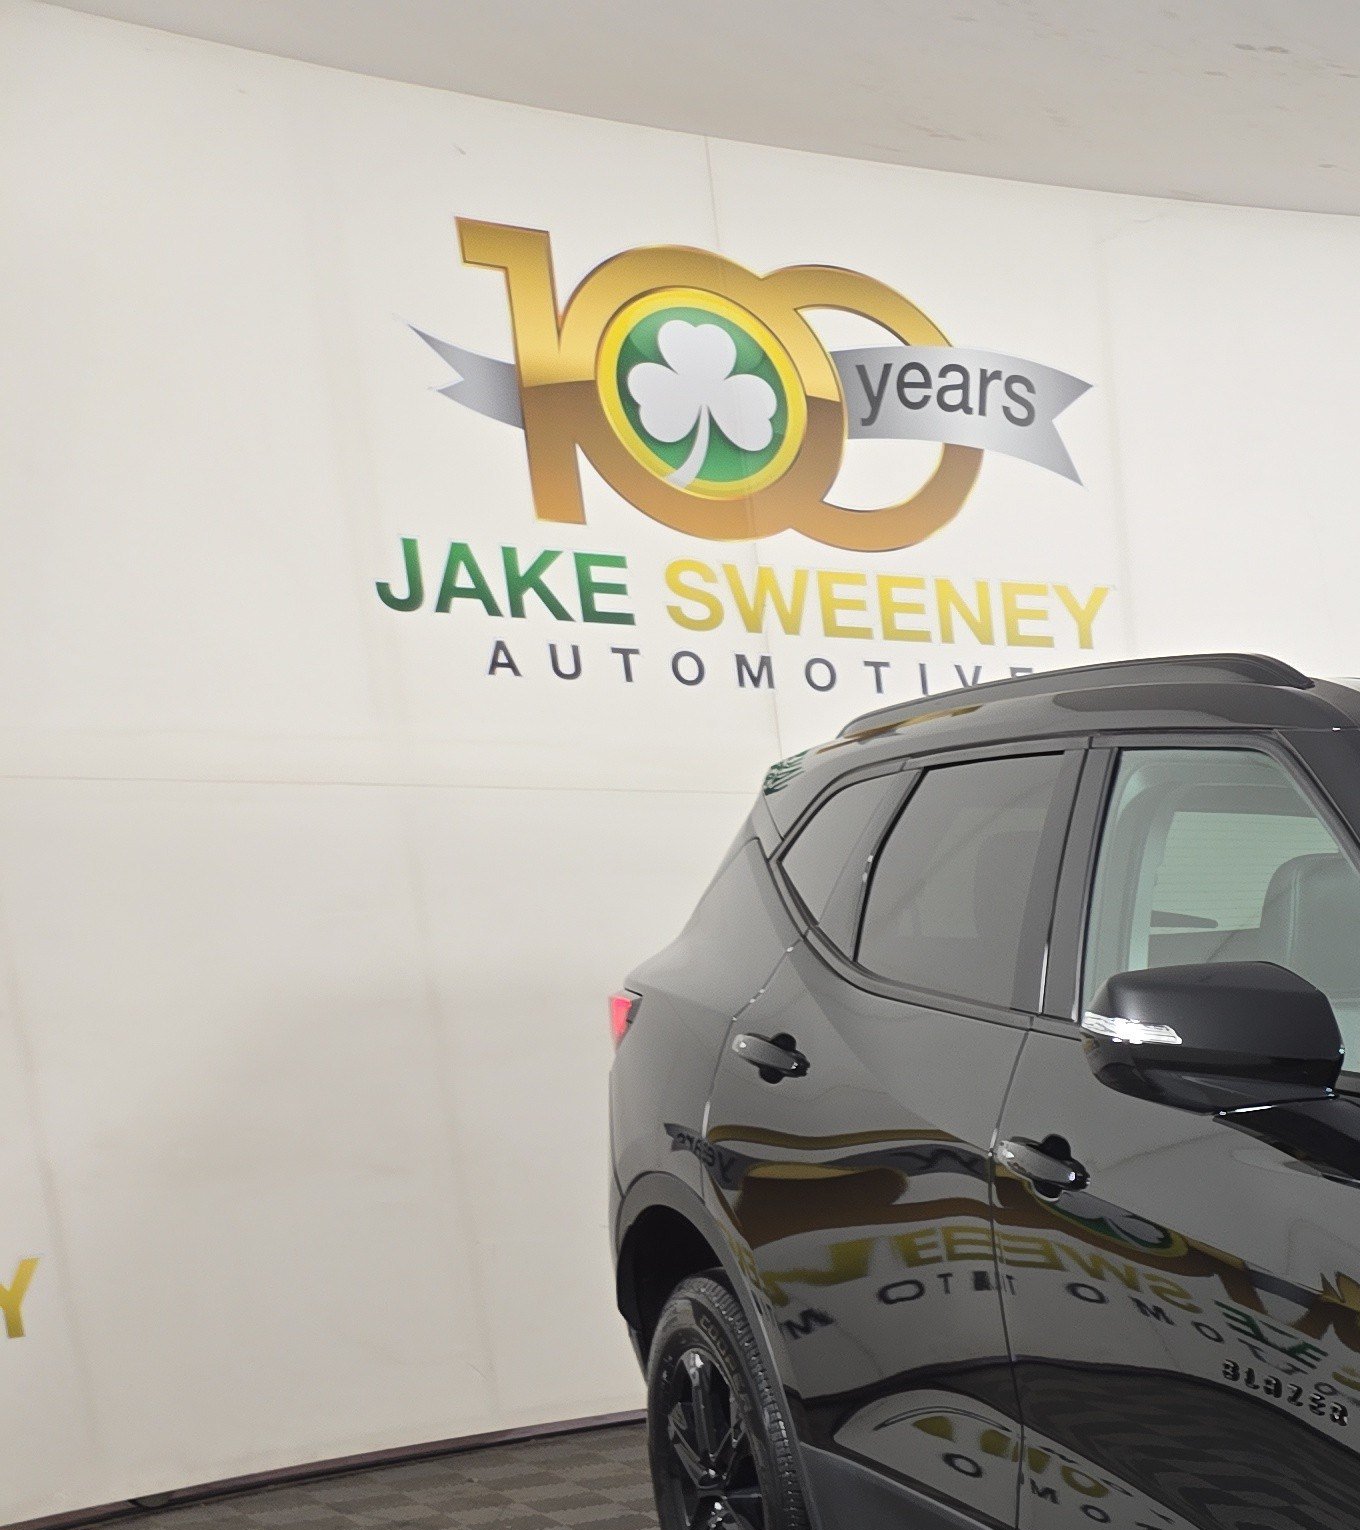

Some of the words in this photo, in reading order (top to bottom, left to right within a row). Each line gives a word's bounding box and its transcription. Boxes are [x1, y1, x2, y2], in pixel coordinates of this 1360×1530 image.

[454, 216, 984, 553] 100
[854, 359, 1037, 428] years
[375, 537, 636, 626] JAKE
[663, 559, 1110, 650] SWEENEY
[1221, 1358, 1350, 1427] BLAZER
